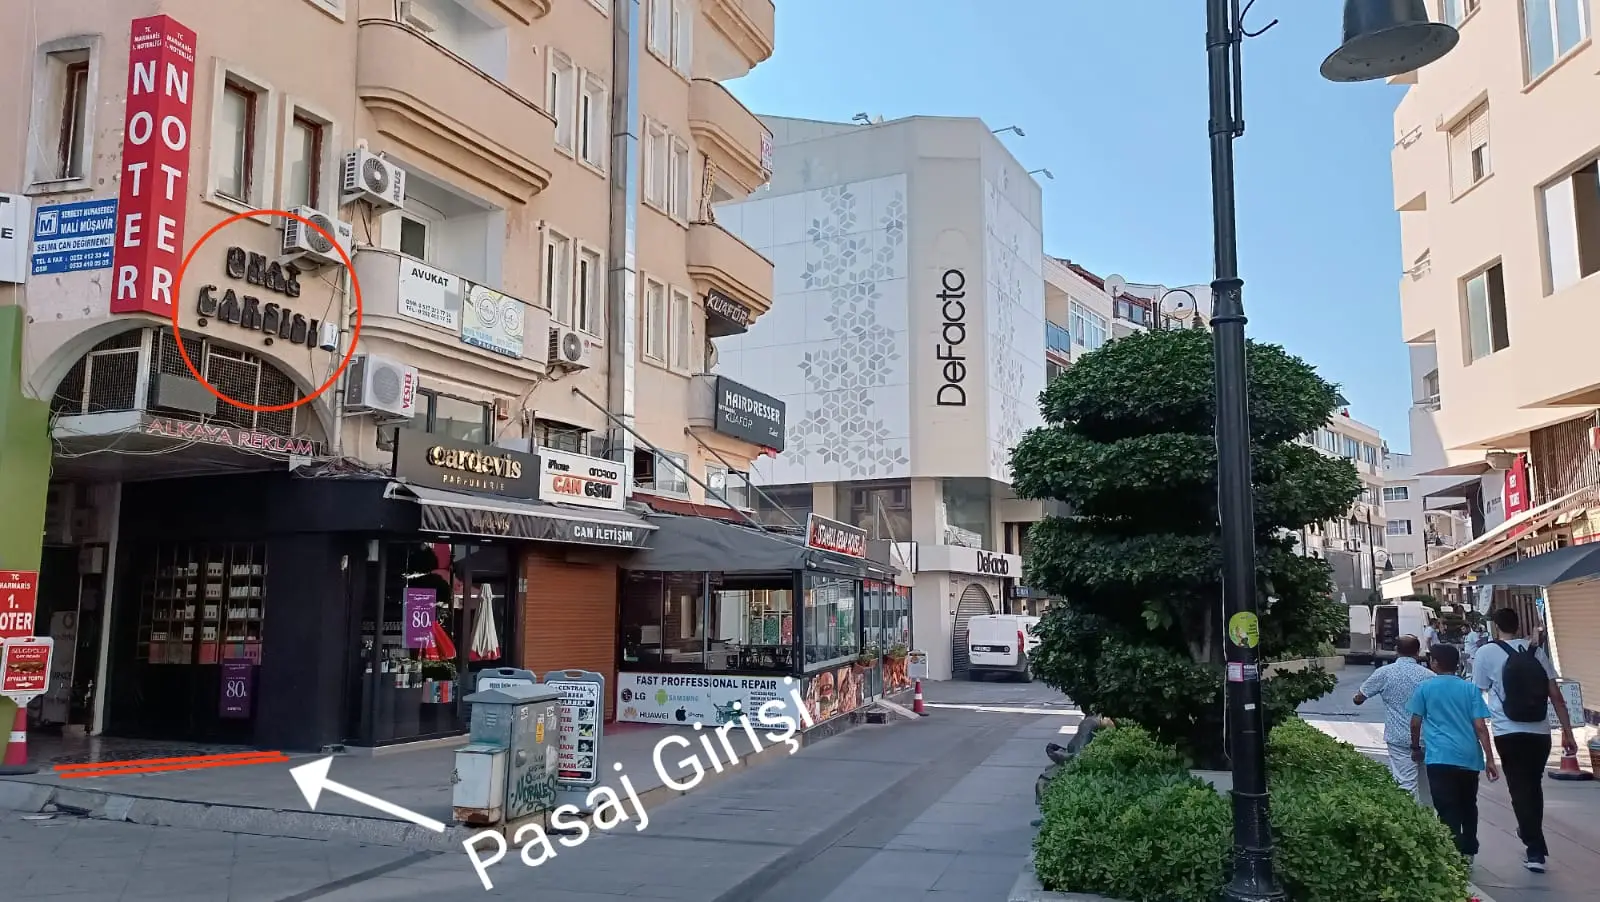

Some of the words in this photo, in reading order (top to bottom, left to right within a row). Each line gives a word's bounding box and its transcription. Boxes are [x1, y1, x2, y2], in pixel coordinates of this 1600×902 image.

[117, 60, 156, 300] NOTER
[151, 61, 189, 305] NOTER
[37, 242, 57, 252] SELMA
[58, 241, 71, 250] CAN
[411, 268, 449, 287] AVUKAT
[936, 269, 966, 406] DeFacto
[402, 373, 412, 408] VESTEL
[725, 390, 780, 425] HAIRDRESSER
[146, 418, 232, 445] ALKAYA
[238, 431, 314, 456] REKLAM
[552, 476, 582, 495] CAN
[584, 482, 612, 499] GSM
[574, 526, 594, 538] CAN
[596, 525, 633, 543] İLETİŞİM
[976, 551, 1009, 575] DeFacto
[8, 594, 19, 608] 1.
[636, 676, 658, 685] FAST
[662, 677, 738, 689] PROFFESSIONAL
[742, 680, 777, 690] REPAIR
[634, 692, 646, 700] LG
[640, 712, 669, 720] HUAWEI
